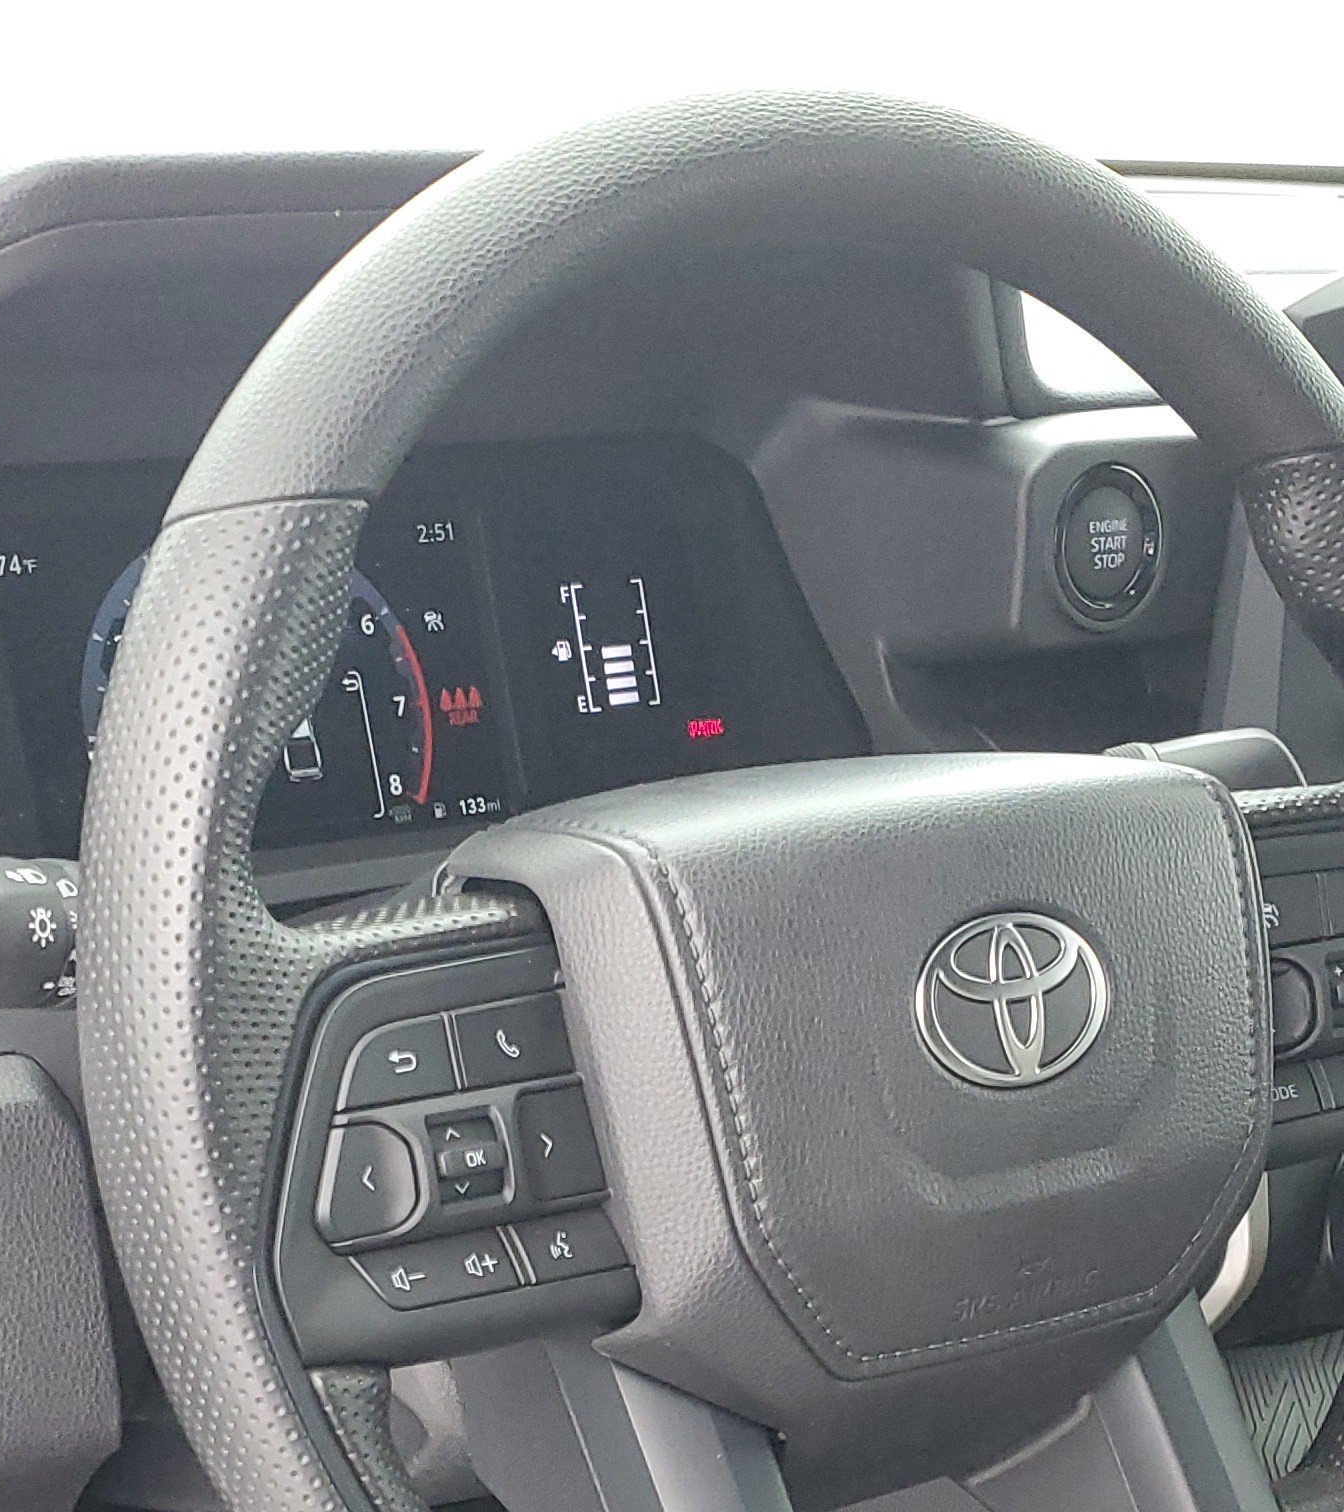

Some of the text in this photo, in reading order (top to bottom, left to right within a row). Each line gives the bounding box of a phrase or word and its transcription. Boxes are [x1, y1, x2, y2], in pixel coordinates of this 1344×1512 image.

[416, 521, 454, 543] 2:51
[1089, 518, 1129, 533] ENGINE
[1090, 535, 1127, 552] START
[1093, 552, 1125, 569] STOP
[360, 613, 375, 635] 6
[392, 695, 406, 717] 7
[389, 773, 403, 796] 8
[465, 1150, 487, 1167] OK
